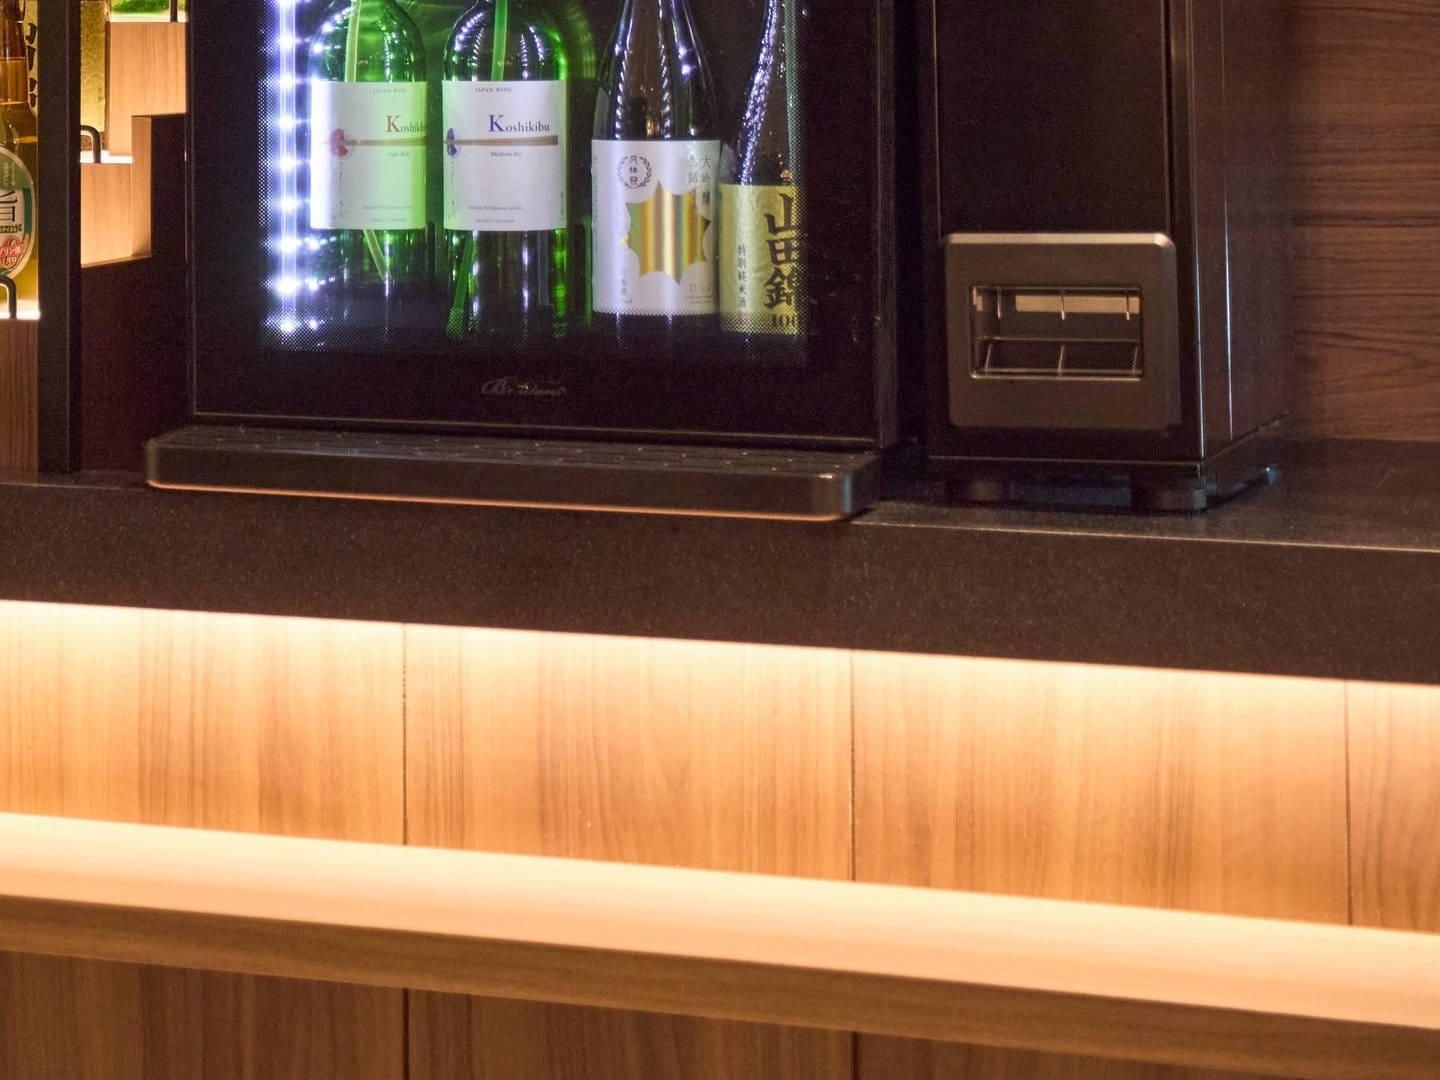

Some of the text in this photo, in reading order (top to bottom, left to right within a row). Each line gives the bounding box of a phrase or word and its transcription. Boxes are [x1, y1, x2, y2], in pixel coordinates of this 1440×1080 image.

[489, 114, 551, 133] Koshikibu
[737, 243, 747, 308] 特別純米酒
